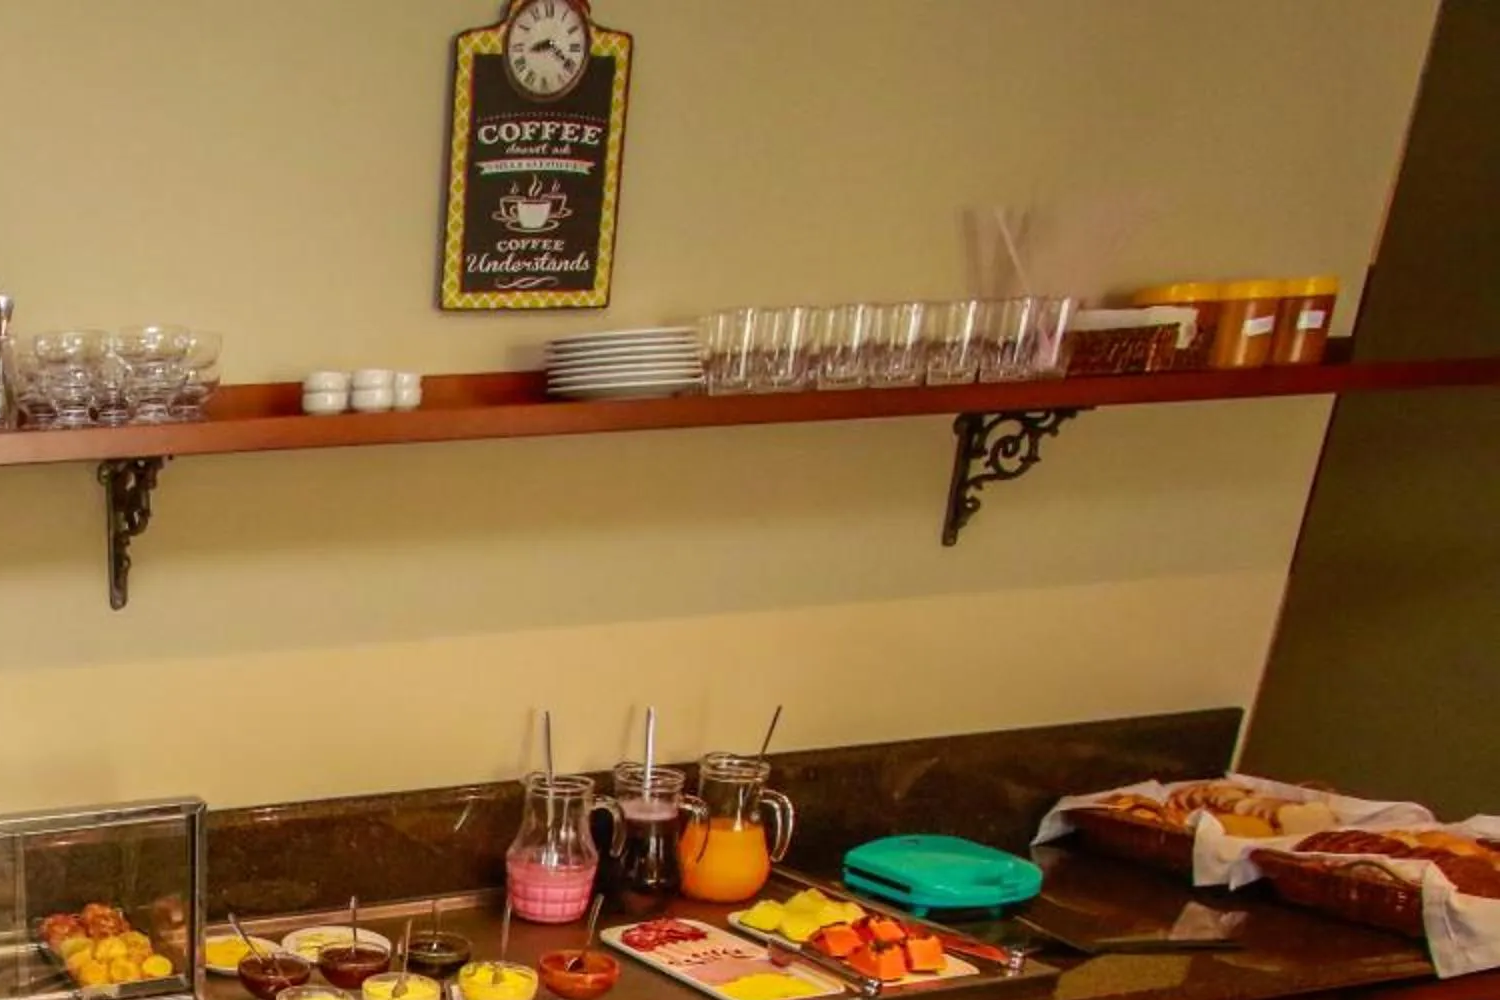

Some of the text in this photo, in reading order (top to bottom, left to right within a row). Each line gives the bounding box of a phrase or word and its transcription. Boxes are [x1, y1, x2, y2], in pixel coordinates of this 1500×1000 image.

[477, 121, 602, 145] COFFEE
[496, 239, 565, 252] COFFEE
[466, 251, 591, 273] Understands
